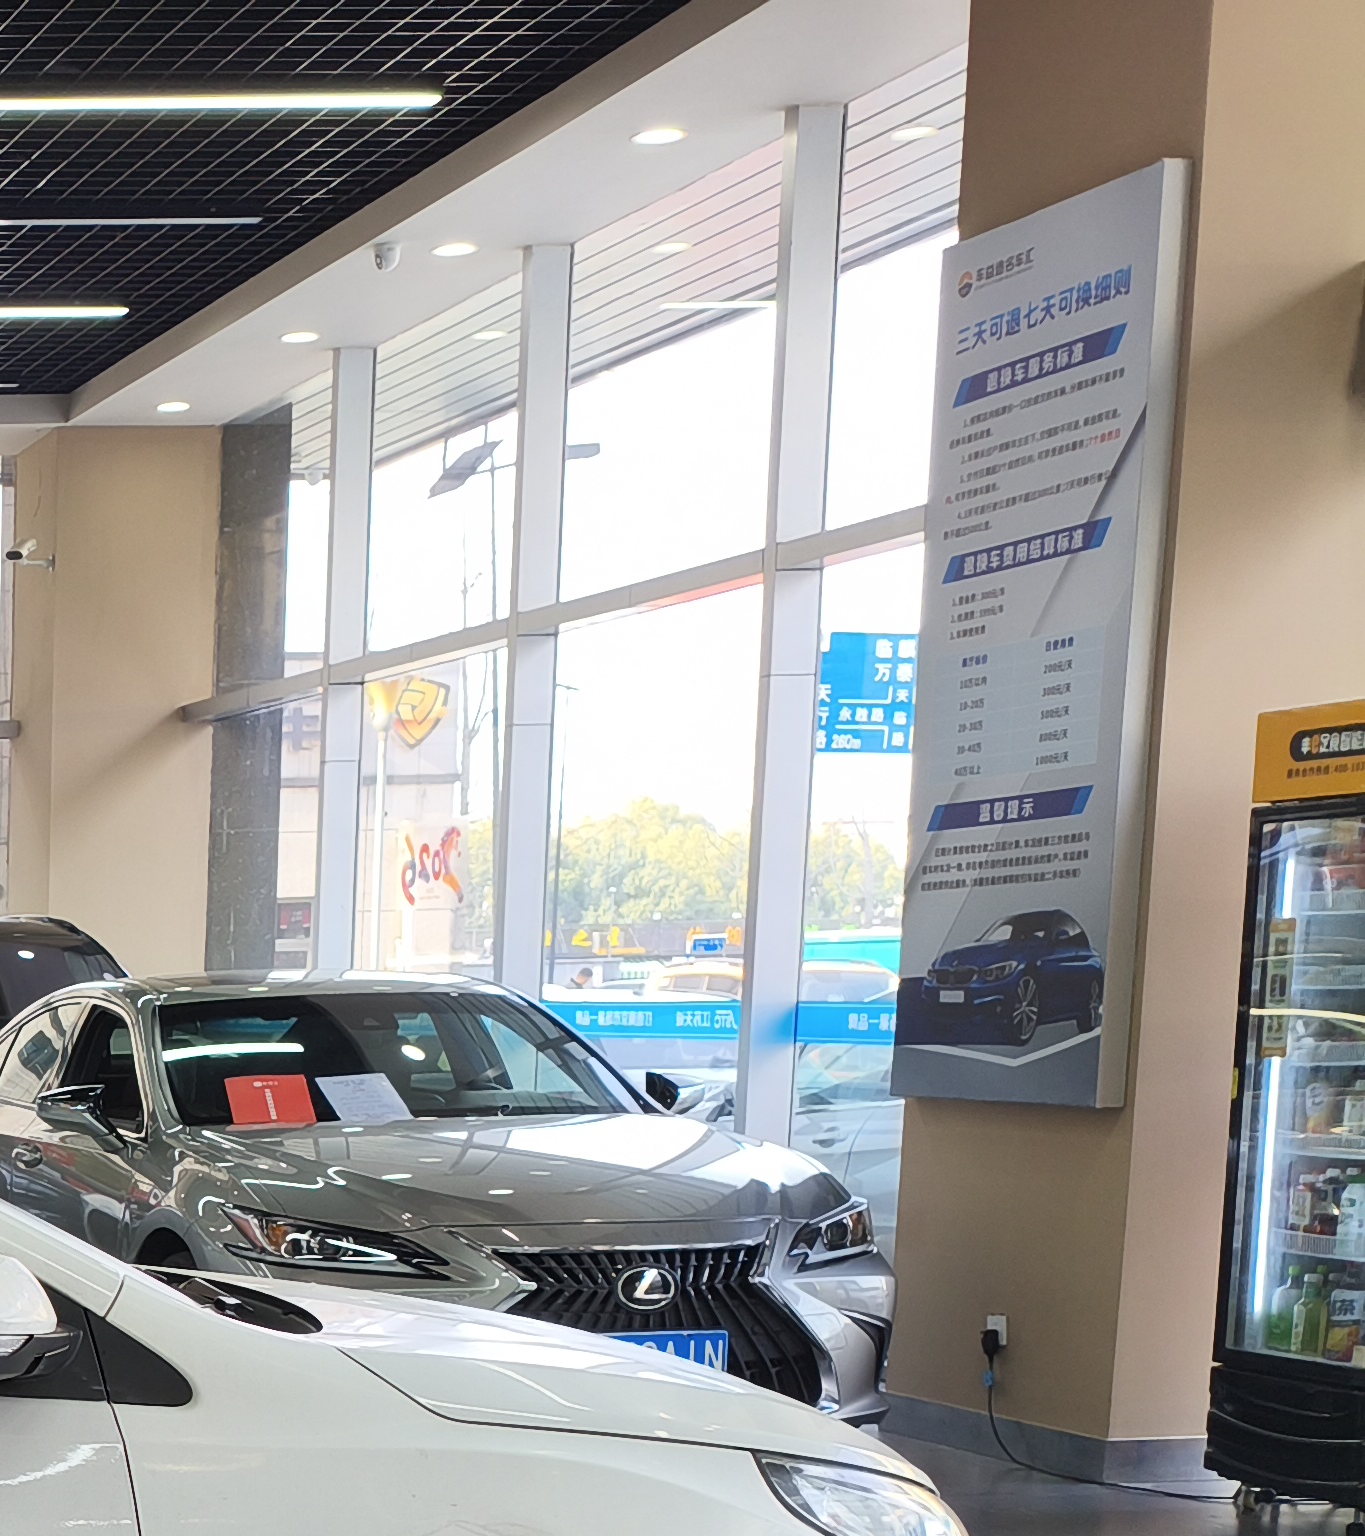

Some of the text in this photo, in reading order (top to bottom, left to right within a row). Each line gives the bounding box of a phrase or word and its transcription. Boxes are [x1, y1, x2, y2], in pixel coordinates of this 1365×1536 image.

[956, 264, 1132, 355] 三天可退七天可换细则
[986, 342, 1085, 392] 退换车服务标准
[963, 528, 1085, 576] 退换车费用结算标准
